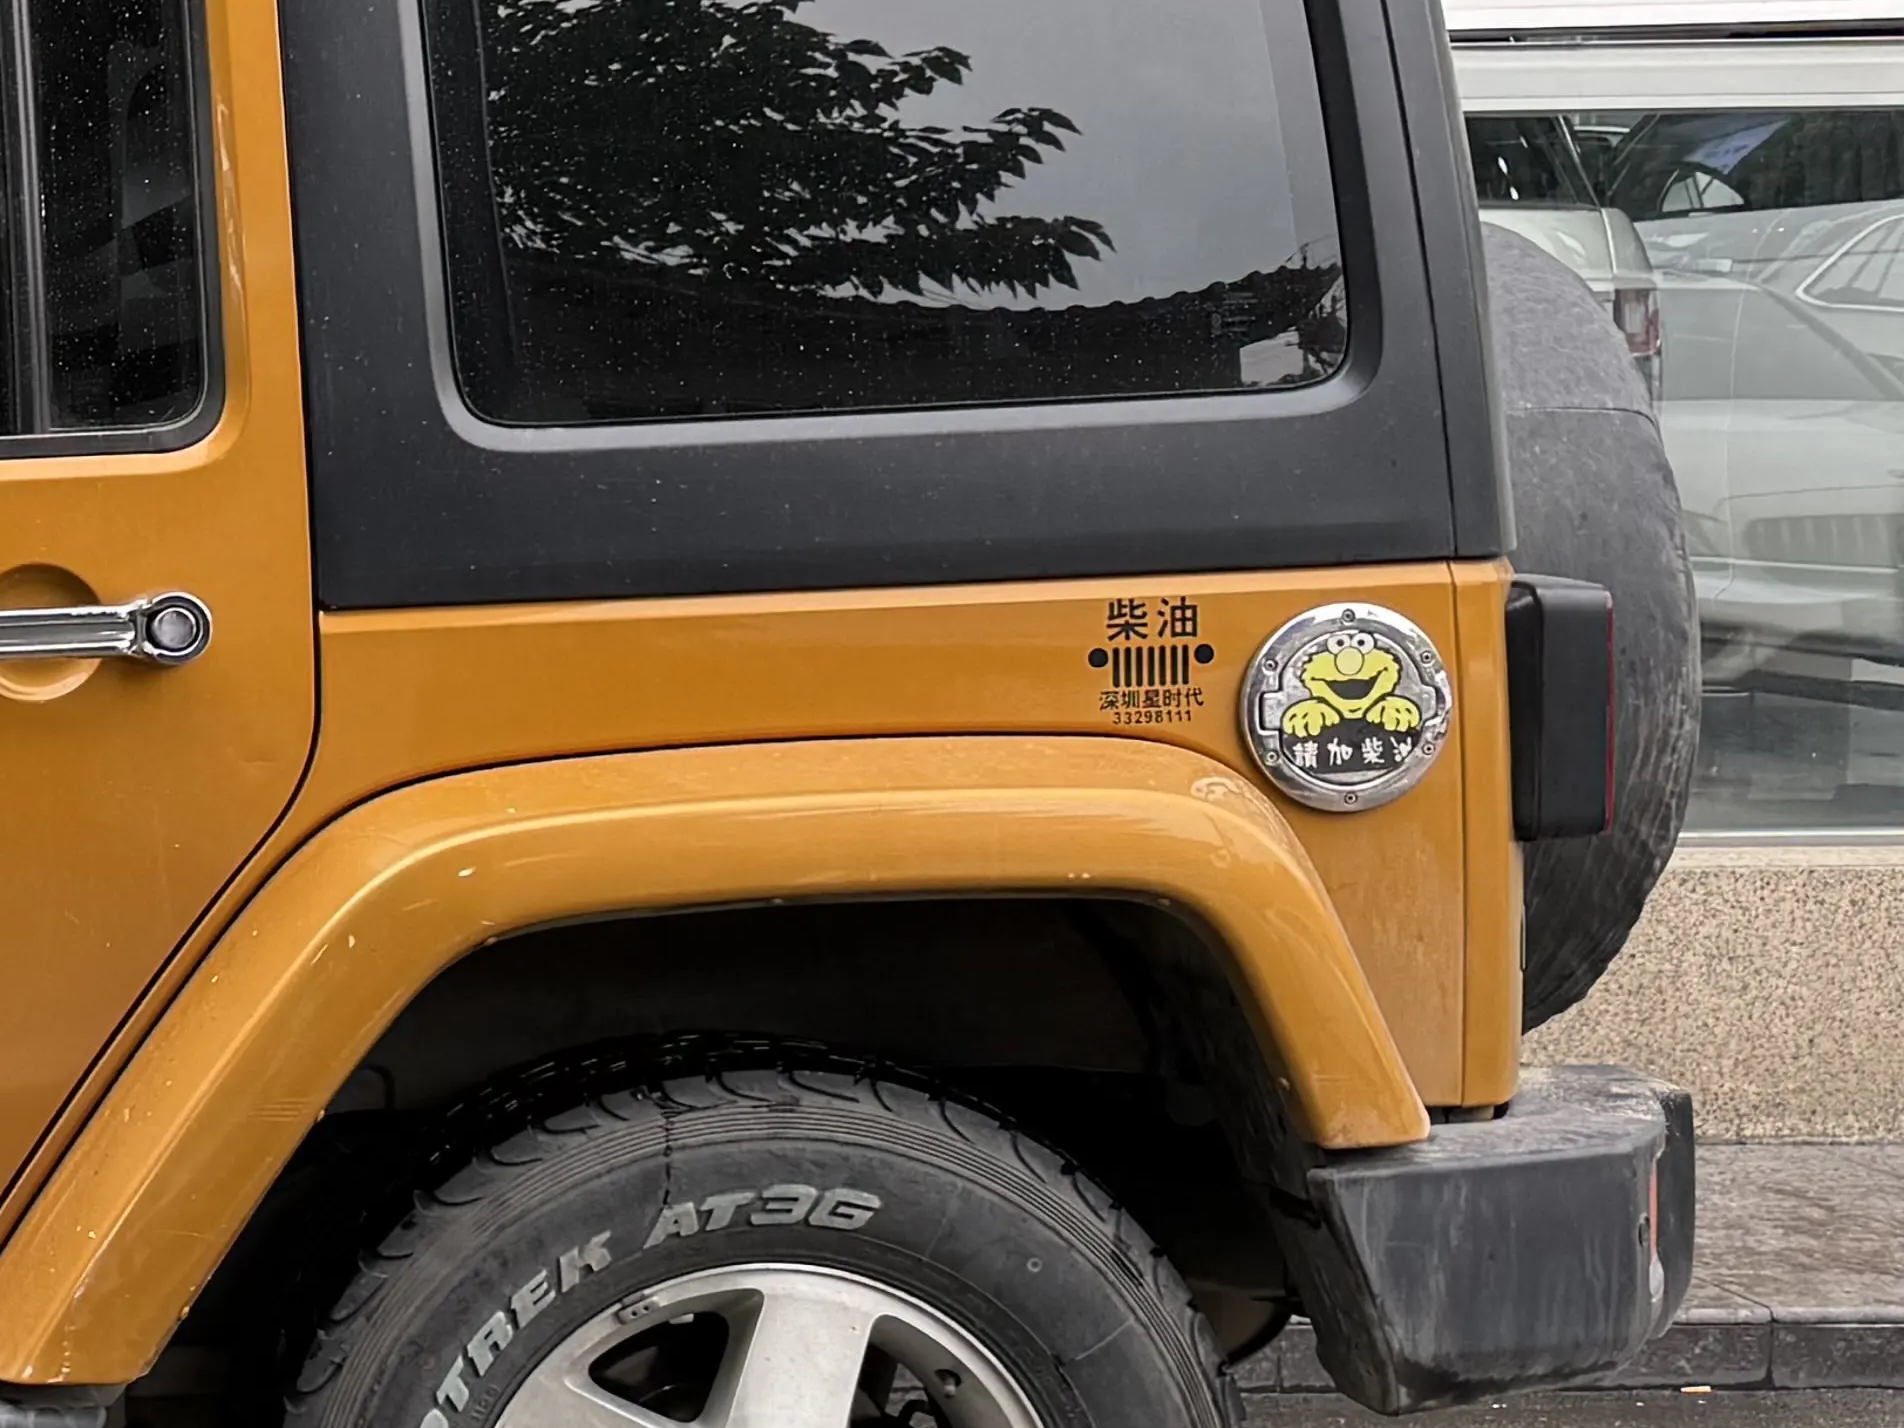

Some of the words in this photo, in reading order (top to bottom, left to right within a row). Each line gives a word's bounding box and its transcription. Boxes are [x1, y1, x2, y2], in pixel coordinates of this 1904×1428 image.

[1106, 595, 1199, 642] 柴油
[1099, 687, 1205, 712] 深圳星时代
[1113, 709, 1192, 725] 33298111
